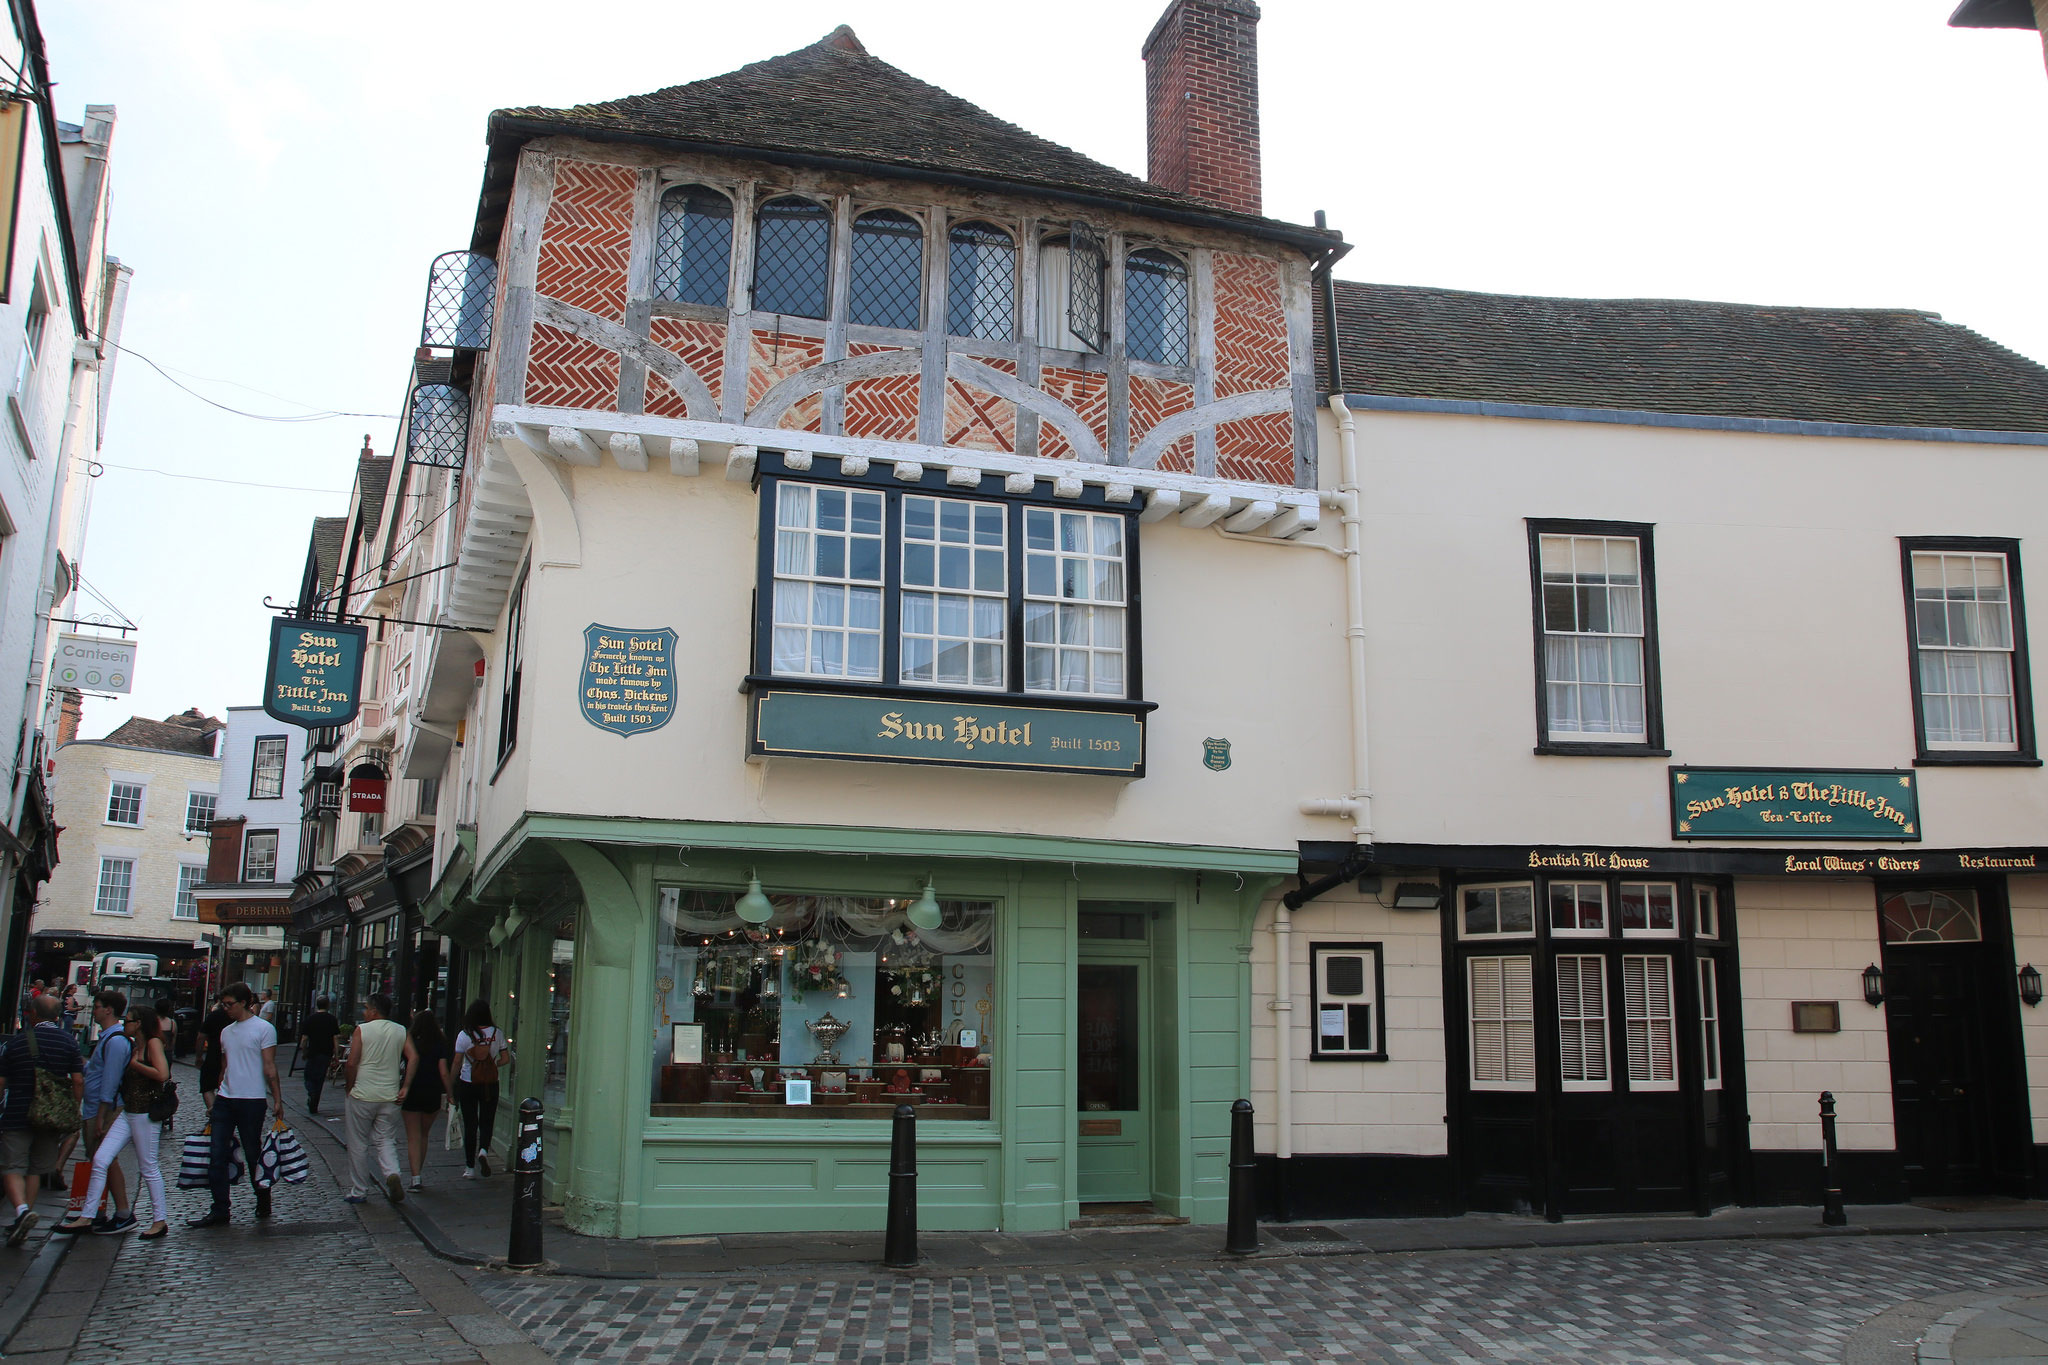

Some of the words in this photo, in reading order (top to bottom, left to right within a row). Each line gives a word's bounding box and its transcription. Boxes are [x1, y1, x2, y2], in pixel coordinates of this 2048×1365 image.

[298, 631, 339, 648] Sun
[597, 636, 625, 650] Sun
[628, 637, 663, 653] Hotel
[63, 645, 129, 663] Canteen
[291, 649, 342, 668] Hotel
[591, 650, 627, 663] Formerly
[629, 653, 653, 662] known
[589, 661, 610, 676] The
[613, 662, 642, 676] Little
[645, 664, 668, 678] Inn
[301, 676, 325, 685] The
[595, 677, 618, 685] made
[620, 677, 650, 688] famous
[651, 679, 662, 691] by
[278, 685, 317, 700] Little
[318, 688, 348, 704] Inn
[586, 687, 621, 700] Chas.
[624, 689, 668, 702] Dickens
[312, 705, 331, 713] 1503
[595, 701, 606, 710] his
[607, 702, 632, 711] travels
[649, 703, 668, 713] Kent
[602, 712, 627, 723] Built
[631, 714, 652, 724] 1503
[877, 711, 946, 742] Sun
[953, 715, 1033, 750] Hotel
[1050, 736, 1082, 750] Built
[1088, 738, 1121, 751] 1503
[352, 792, 382, 800] STRADA
[1686, 796, 1726, 820] Sun
[1725, 784, 1775, 808] Hotel
[1791, 781, 1829, 802] The
[1828, 784, 1876, 811] Little
[1873, 796, 1906, 826] Inn
[1760, 809, 1784, 823] Tea
[1528, 850, 1580, 868] Kentish
[1582, 852, 1607, 868] Ale
[1609, 851, 1650, 870] House
[1785, 854, 1821, 873] Local
[1822, 855, 1866, 873] Wines
[1878, 855, 1921, 872] Ciders
[1958, 854, 2036, 869] Restaurant
[53, 941, 64, 949] 38
